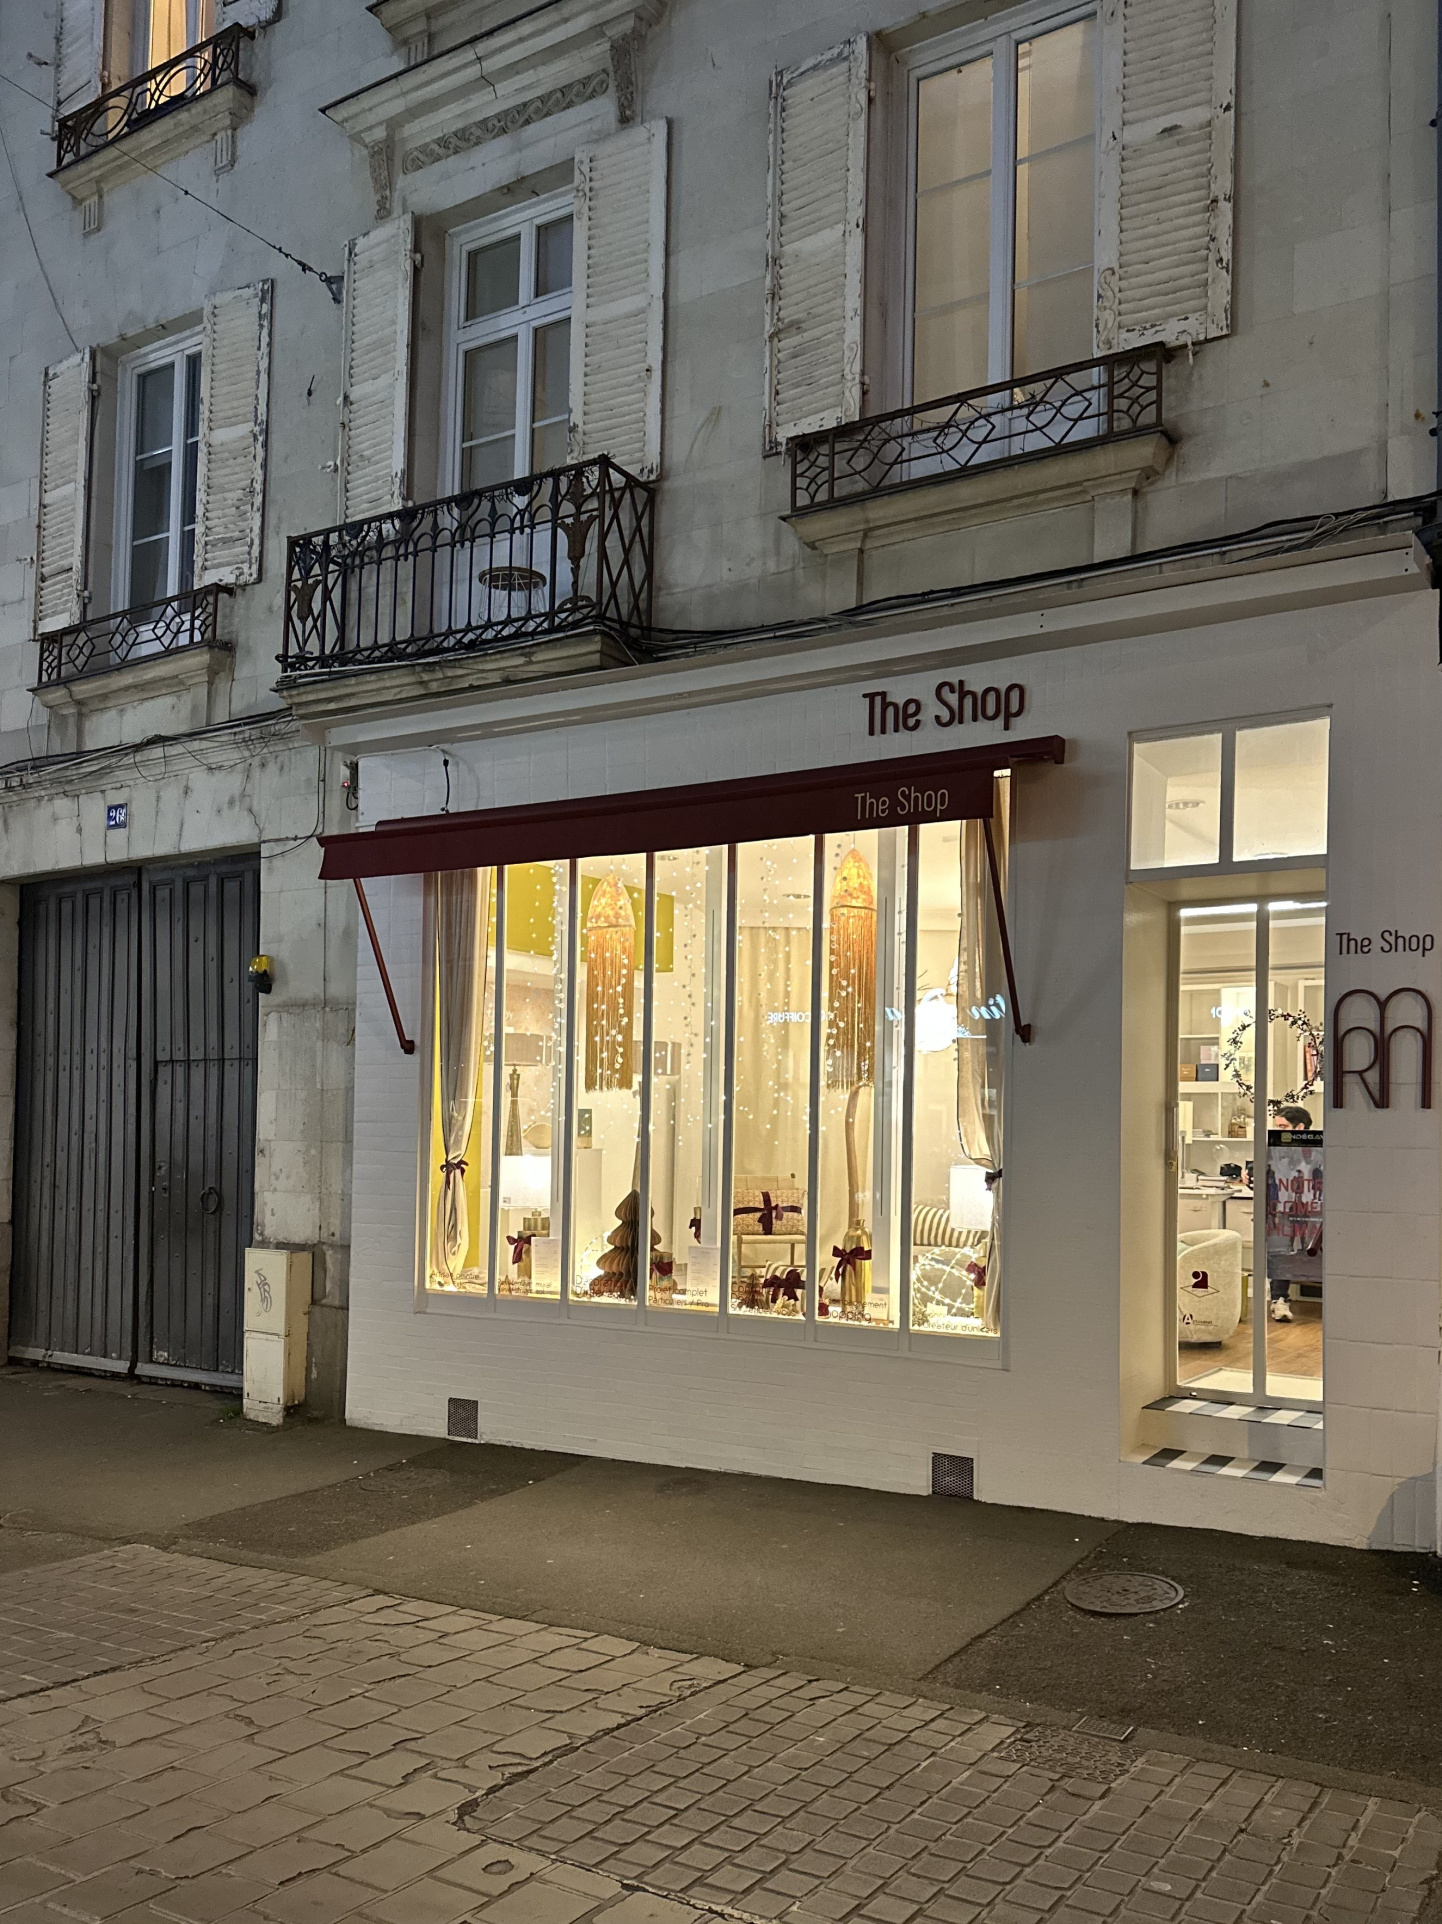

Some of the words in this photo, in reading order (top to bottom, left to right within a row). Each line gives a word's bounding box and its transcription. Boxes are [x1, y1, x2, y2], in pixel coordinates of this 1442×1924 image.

[862, 690, 922, 736] The
[934, 679, 1026, 731] Shop
[854, 791, 890, 820] The
[897, 786, 949, 817] Shop
[1335, 932, 1372, 956] The
[1380, 929, 1435, 958] Shop
[696, 1299, 710, 1308] Pro
